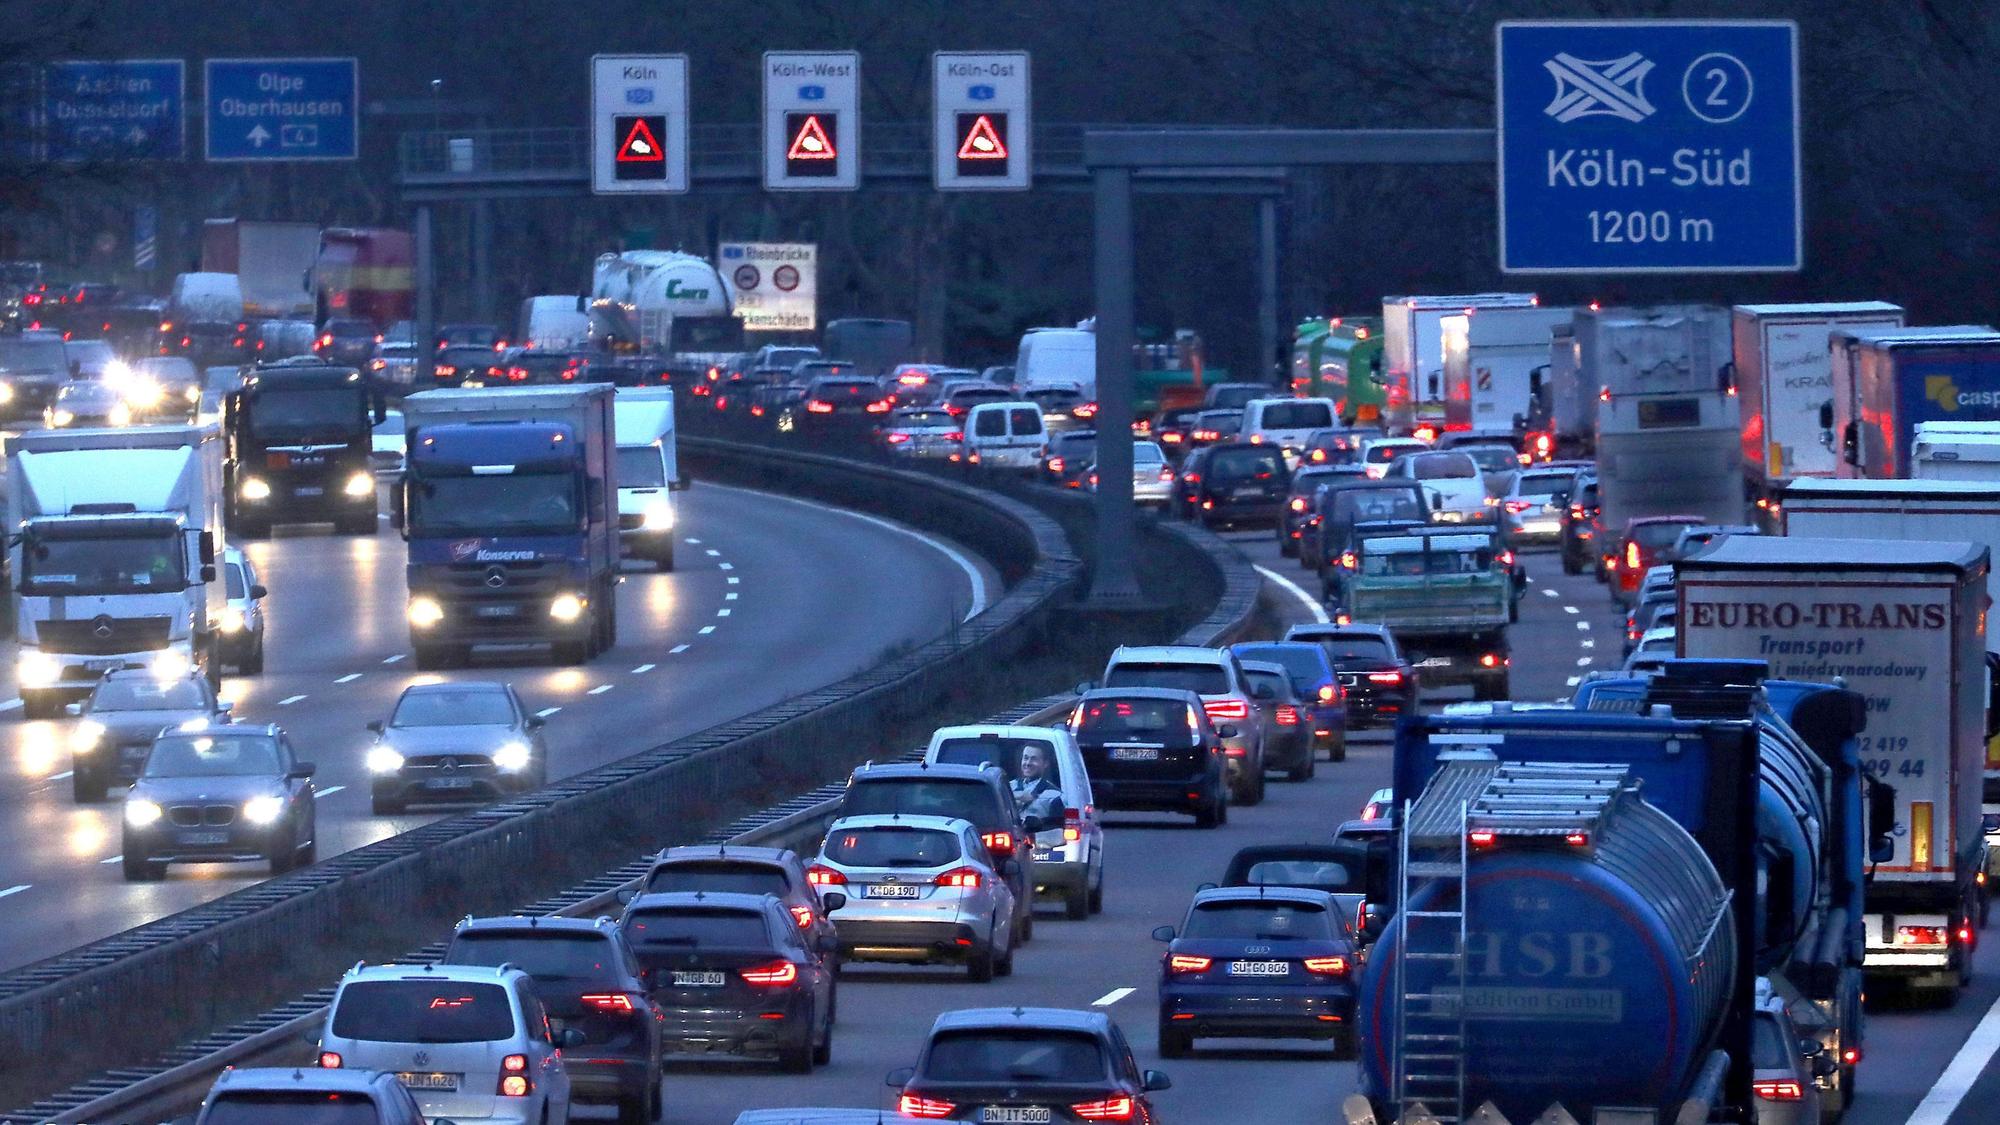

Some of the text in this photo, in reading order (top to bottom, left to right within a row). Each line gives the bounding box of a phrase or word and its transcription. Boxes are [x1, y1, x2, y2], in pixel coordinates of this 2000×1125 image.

[623, 66, 657, 80] Köln
[773, 64, 850, 77] Köln-West
[948, 64, 1014, 77] Köln-Ost
[258, 72, 304, 94] Olpe
[1706, 68, 1728, 106] 2
[219, 98, 343, 117] Oberhausen
[295, 130, 304, 142] 4
[1547, 148, 1751, 187] Köln-Süd
[1588, 210, 1713, 243] 1200 m
[1785, 376, 1830, 388] KRA
[476, 549, 535, 560] Konserven
[1689, 602, 1946, 630] EURO-TRANS
[1759, 634, 1865, 656] Transport
[1785, 661, 1926, 679] międzynarodowy
[1876, 736, 1908, 751] 419
[1858, 759, 1925, 778] 99 44
[870, 886, 877, 895] K
[898, 886, 915, 896] 190
[1447, 931, 1613, 978] HSB
[1232, 963, 1287, 973] SU GO 806
[691, 973, 705, 983] GB
[708, 973, 721, 983] 60
[1439, 991, 1614, 1009] Spedition GmbH
[426, 1075, 454, 1086] 1026
[984, 1108, 1049, 1121] BN IT 5000
